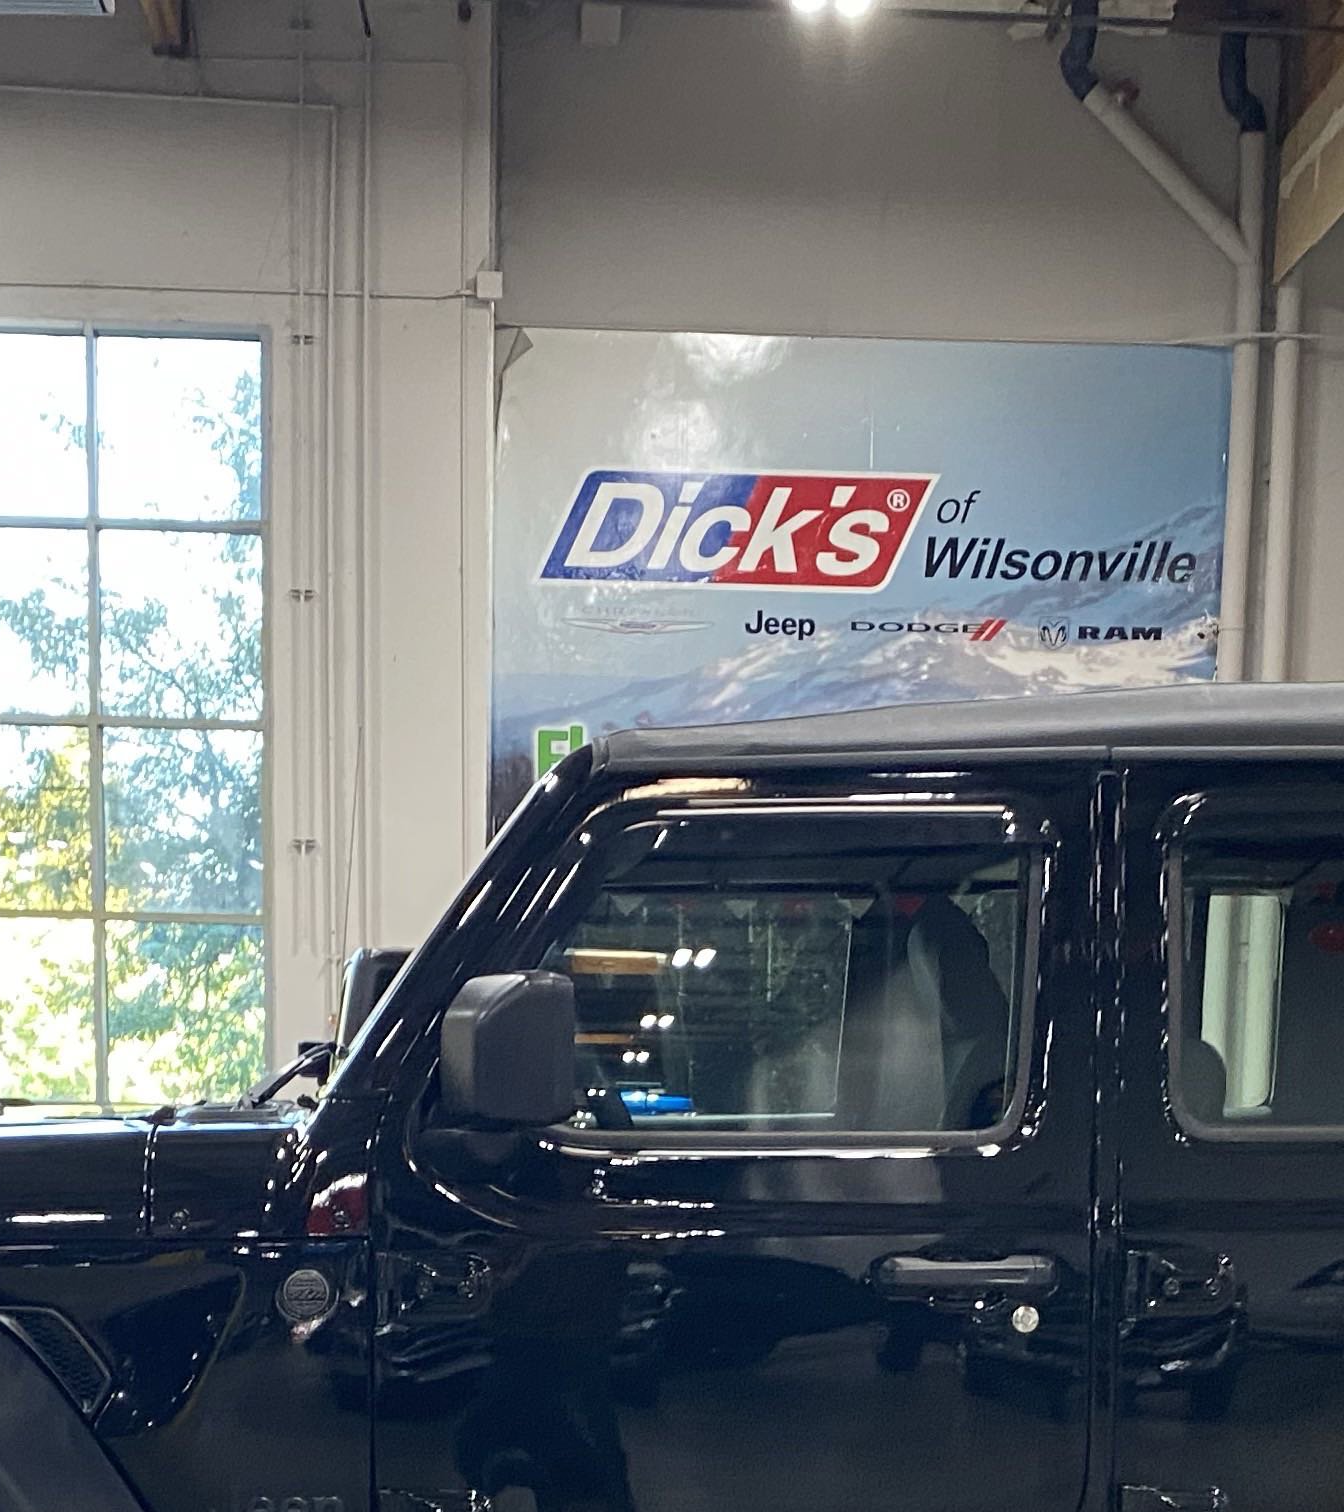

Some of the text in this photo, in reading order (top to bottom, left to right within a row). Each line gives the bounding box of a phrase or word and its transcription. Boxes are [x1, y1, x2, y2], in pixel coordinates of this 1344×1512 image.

[937, 490, 981, 524] of
[924, 536, 1197, 583] Wilsonville
[745, 610, 816, 640] Jeep
[851, 621, 984, 634] DODGE
[1078, 626, 1163, 641] RAM
